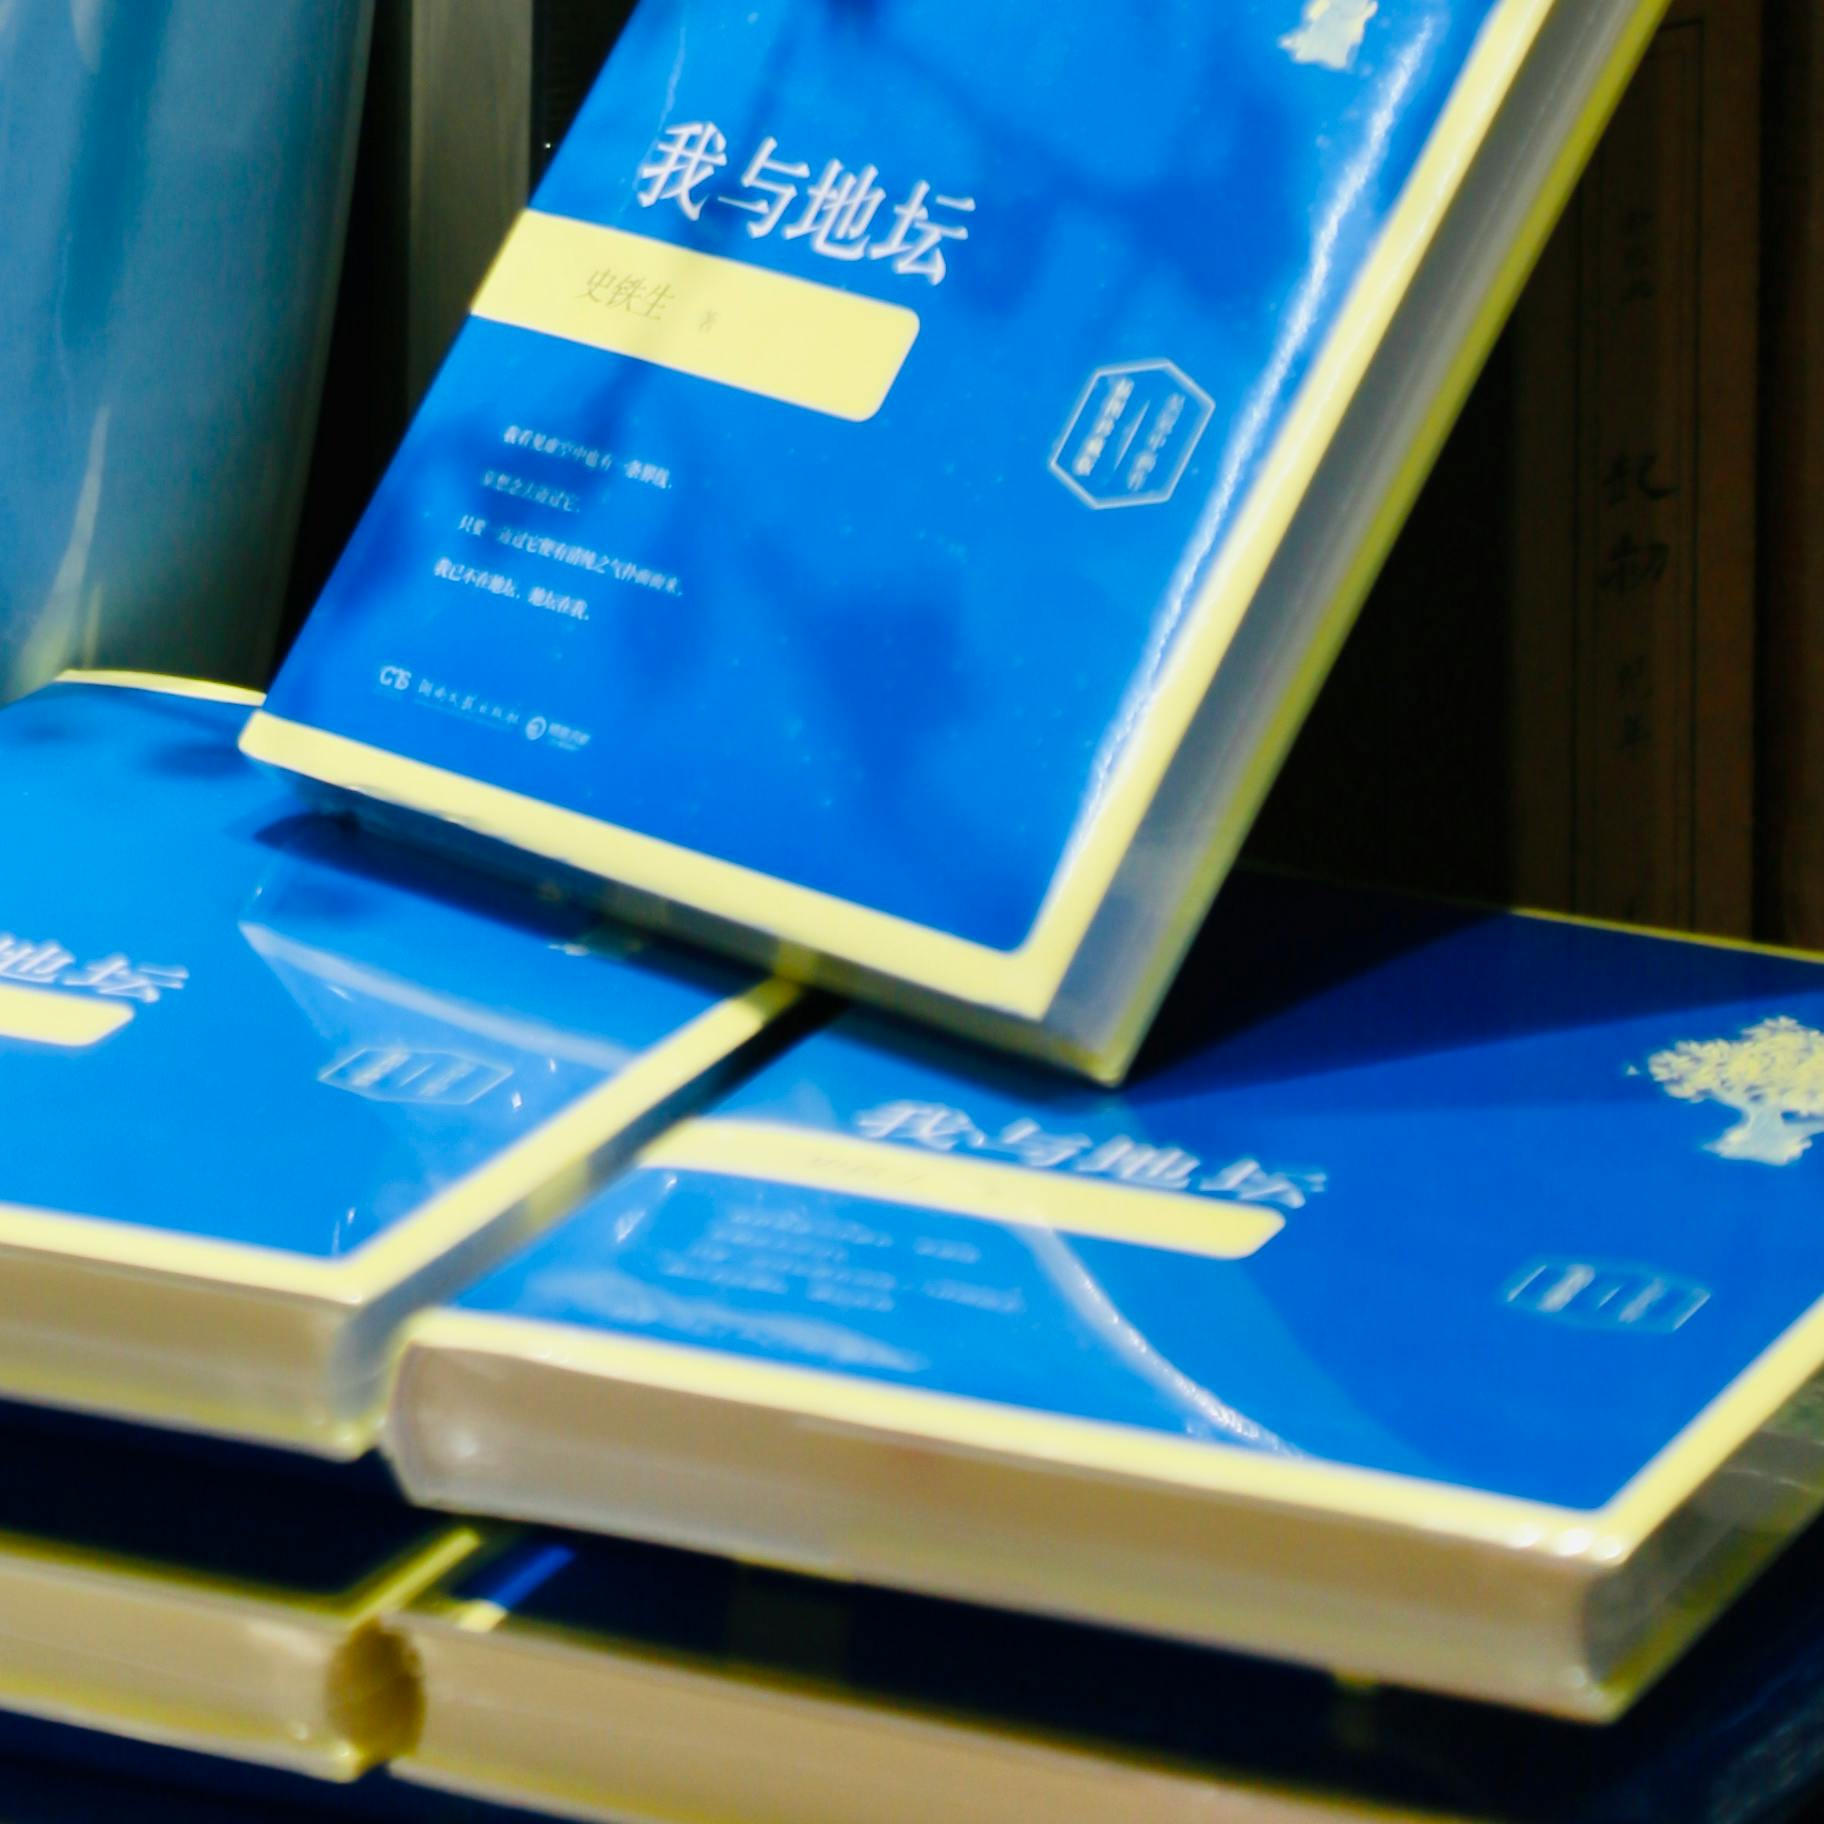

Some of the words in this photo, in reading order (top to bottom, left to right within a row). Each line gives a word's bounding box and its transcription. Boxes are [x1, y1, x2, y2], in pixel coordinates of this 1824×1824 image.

[637, 121, 976, 287] 我与地坛
[577, 267, 676, 321] 史铁生
